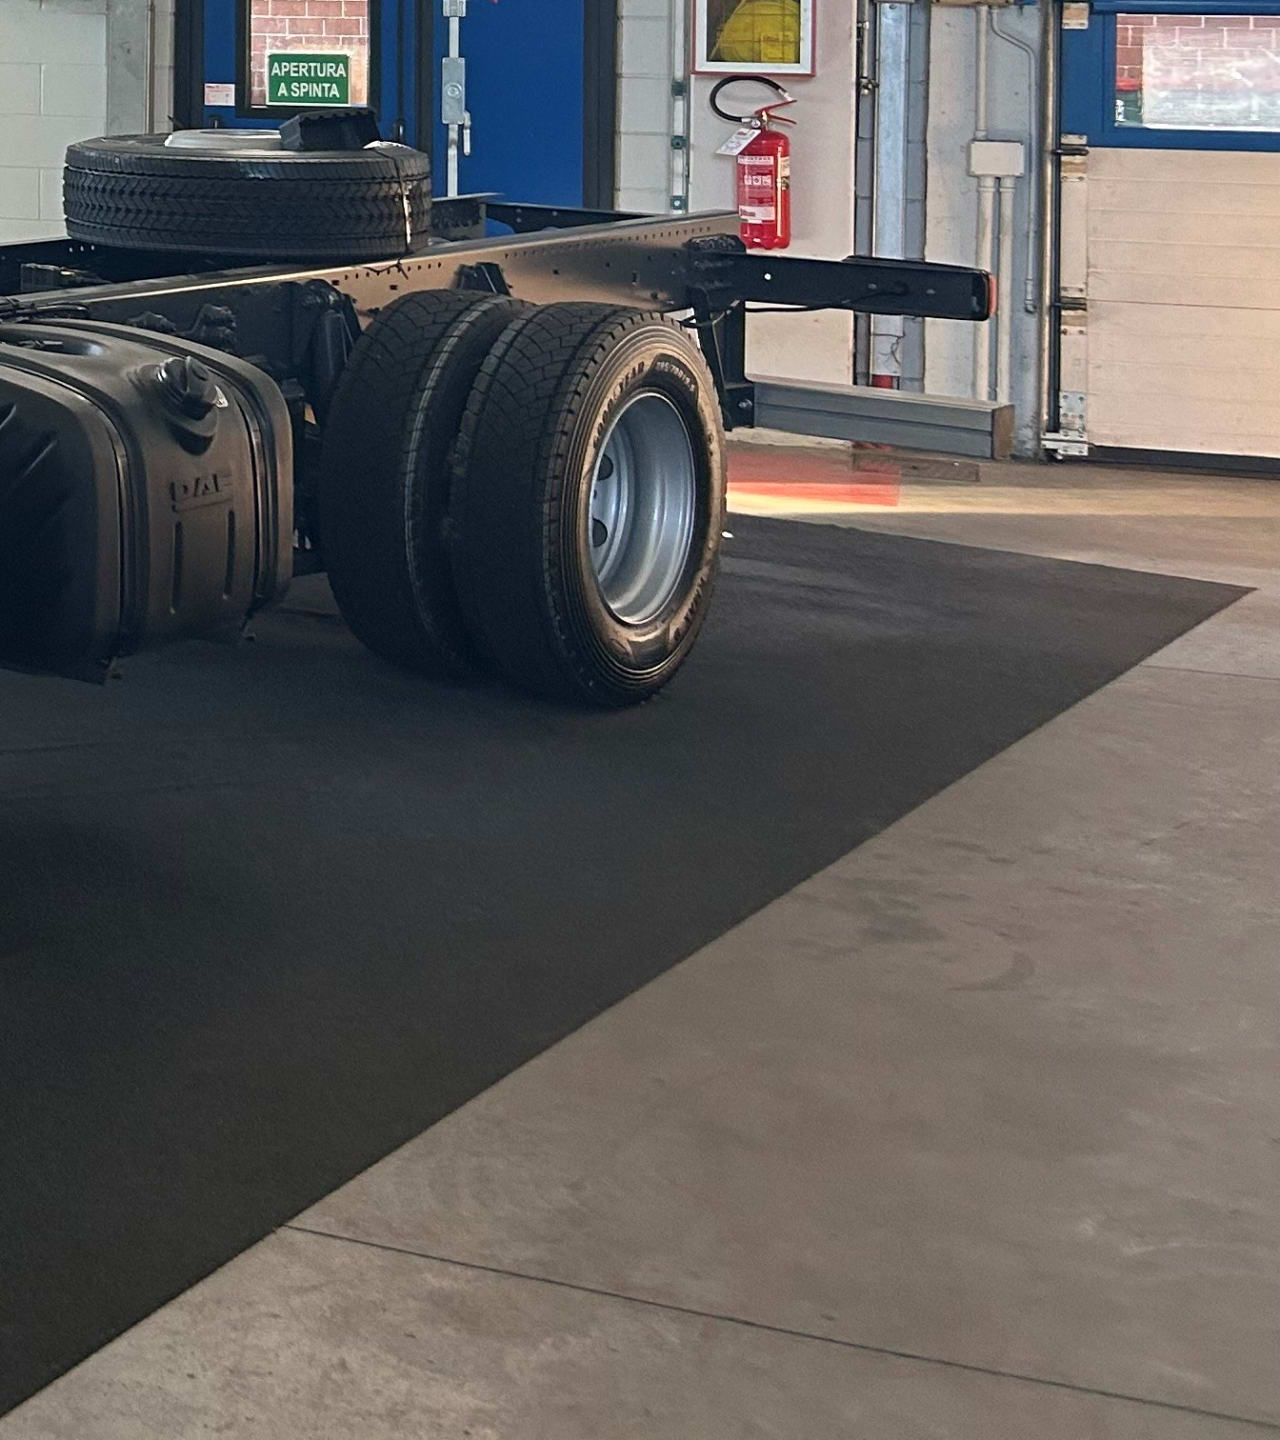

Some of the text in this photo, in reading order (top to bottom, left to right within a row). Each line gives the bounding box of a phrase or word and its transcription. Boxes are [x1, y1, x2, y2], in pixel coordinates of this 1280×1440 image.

[271, 61, 347, 78] APERTURA
[277, 82, 340, 98] A SPINTA
[168, 471, 233, 502] DAF
